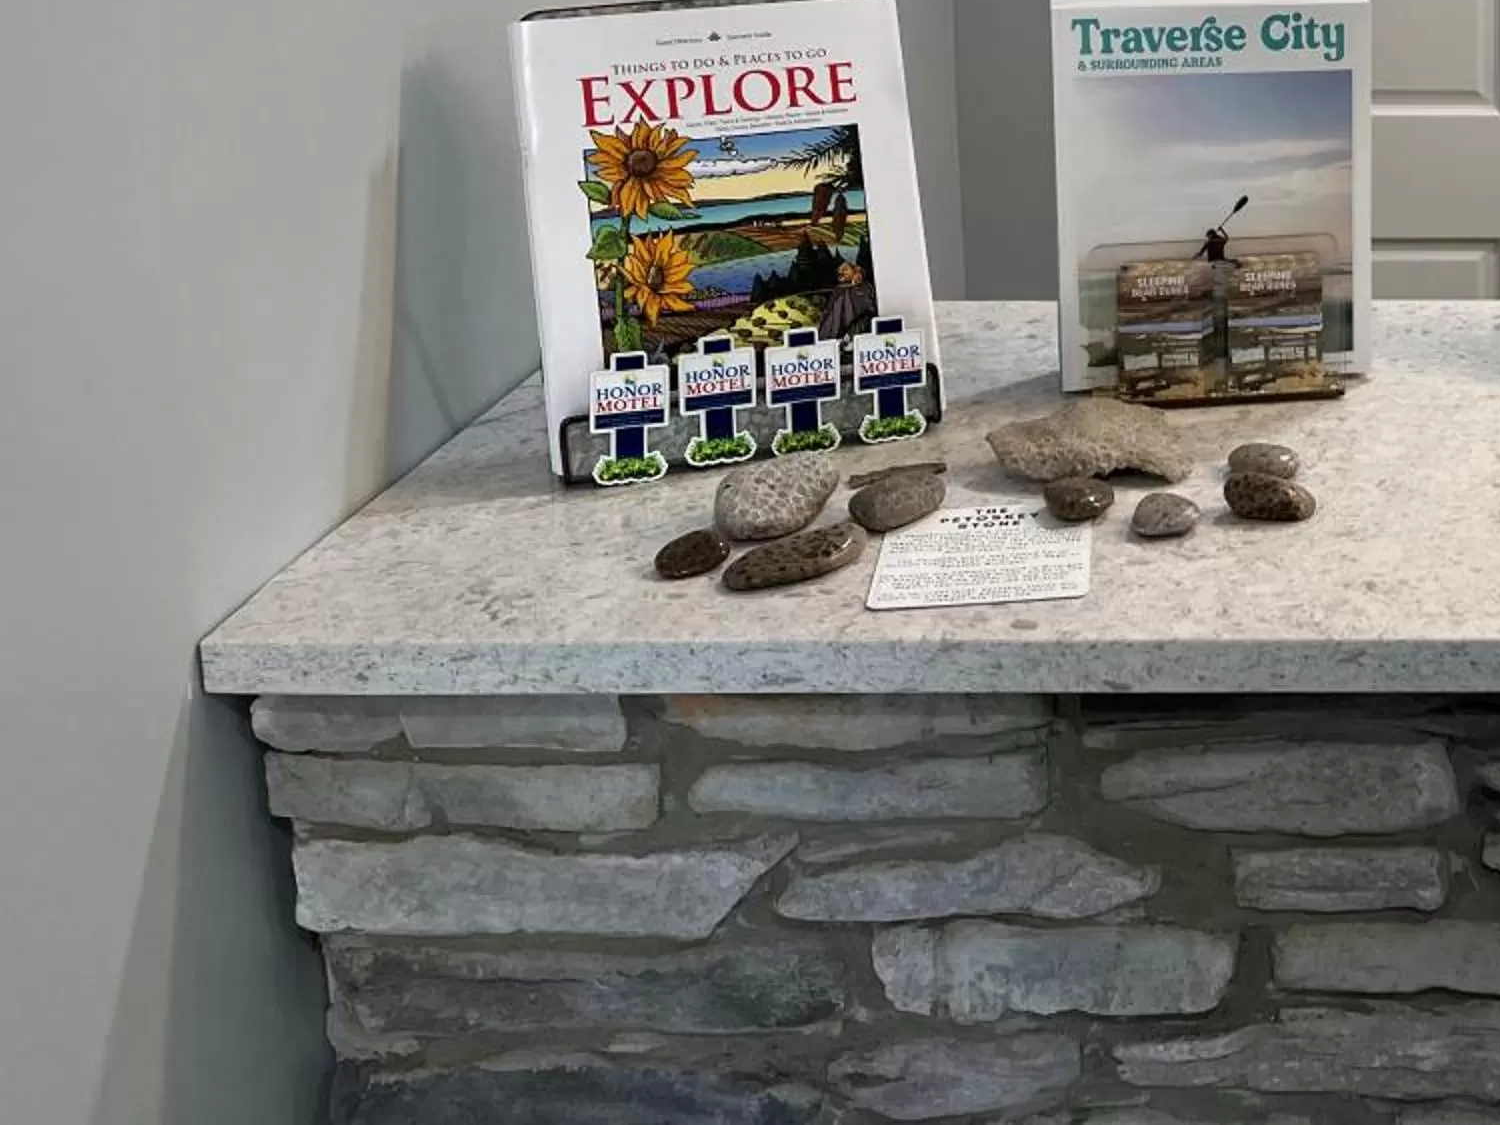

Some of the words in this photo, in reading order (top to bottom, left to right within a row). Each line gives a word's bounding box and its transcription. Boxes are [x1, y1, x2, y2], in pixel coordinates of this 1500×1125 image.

[1071, 15, 1247, 55] Traverse
[1260, 12, 1345, 63] City
[611, 59, 667, 76] THINGS
[671, 59, 689, 72] TO
[693, 57, 715, 69] DO
[719, 56, 731, 67] &
[733, 52, 781, 66] PLACES
[785, 50, 803, 61] TO
[806, 48, 828, 59] GO
[1077, 60, 1087, 71] &
[1090, 58, 1178, 70] SURROUNDING
[1182, 56, 1223, 68] AREAS
[576, 62, 858, 127] EXPLORE
[859, 345, 921, 363] HONOR
[685, 364, 750, 383] HONOR
[771, 358, 836, 376] HONOR
[860, 358, 920, 375] MOTEL
[686, 377, 750, 396] MOTEL
[772, 371, 833, 389] MOTEL
[596, 382, 663, 401] HONOR
[596, 396, 662, 413] MOTEL
[940, 512, 1039, 523] PETOSKEY
[958, 520, 1020, 530] STONE
